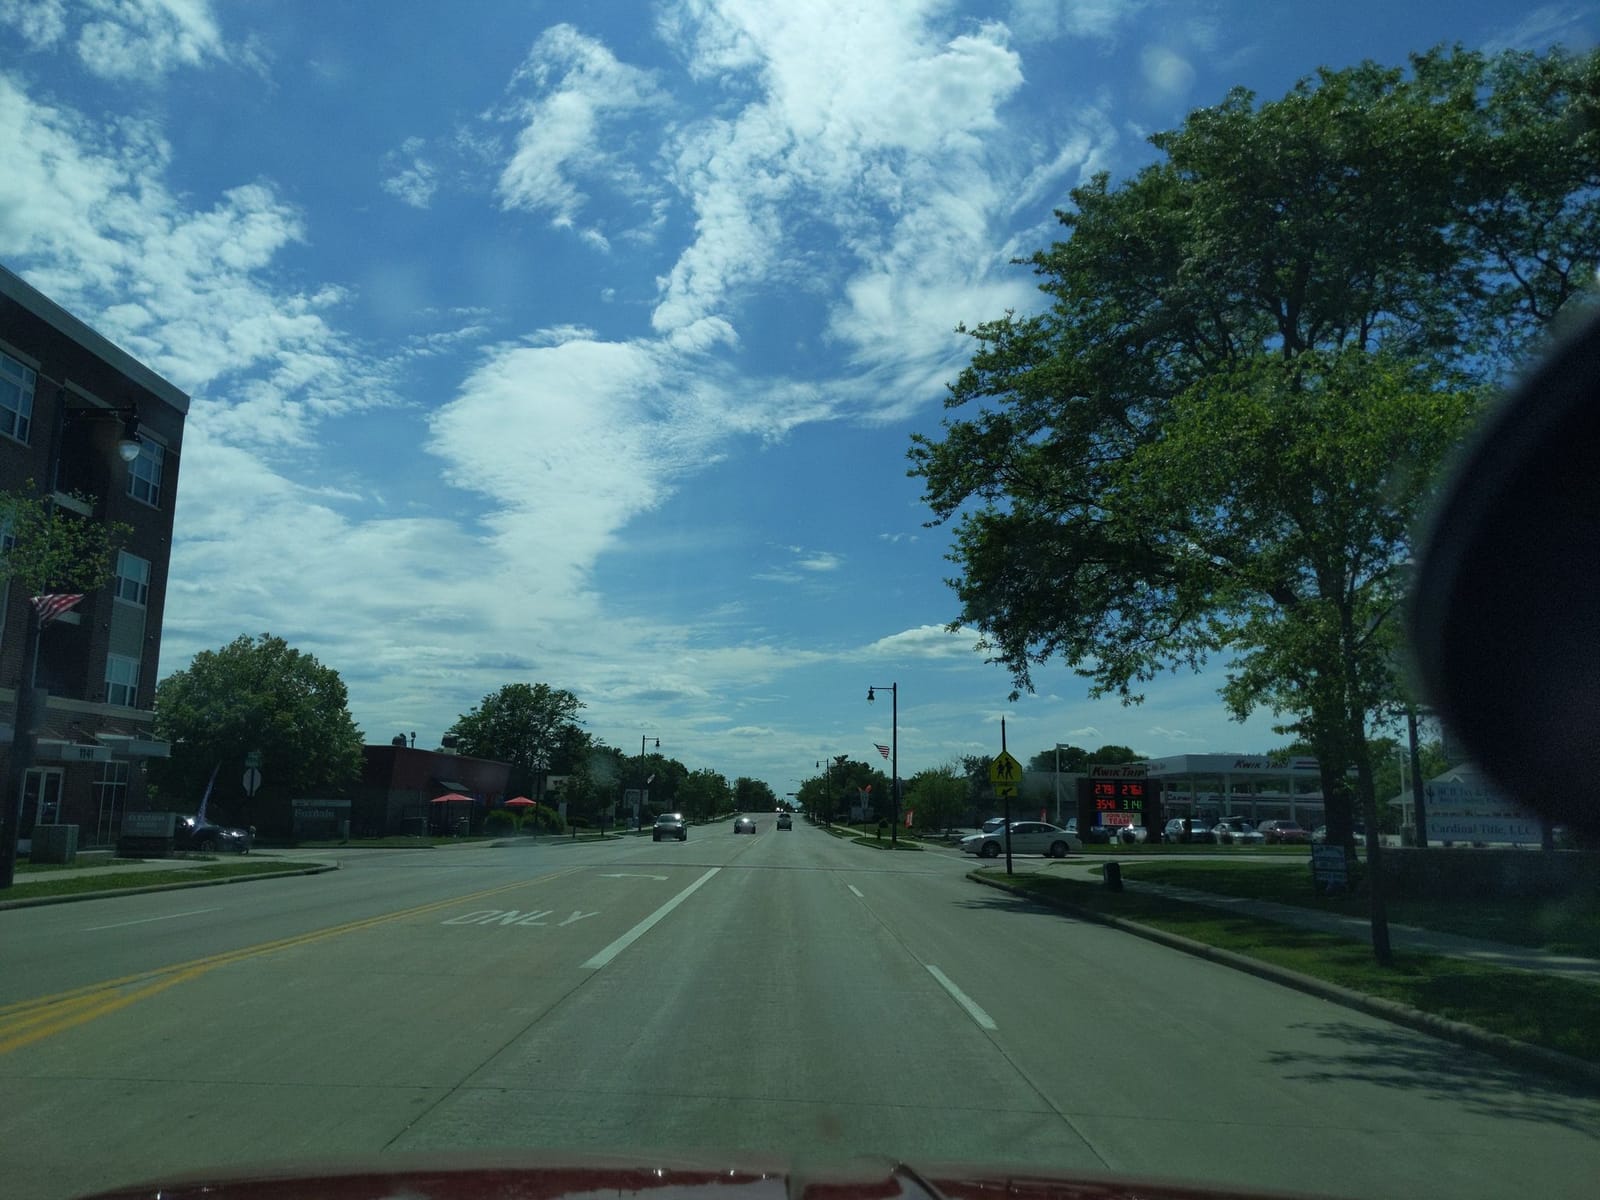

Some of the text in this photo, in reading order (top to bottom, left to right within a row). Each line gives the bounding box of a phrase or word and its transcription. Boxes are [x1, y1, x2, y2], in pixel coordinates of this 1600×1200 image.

[1092, 766, 1145, 777] KWIK TRIP
[440, 910, 600, 927] ONLY
